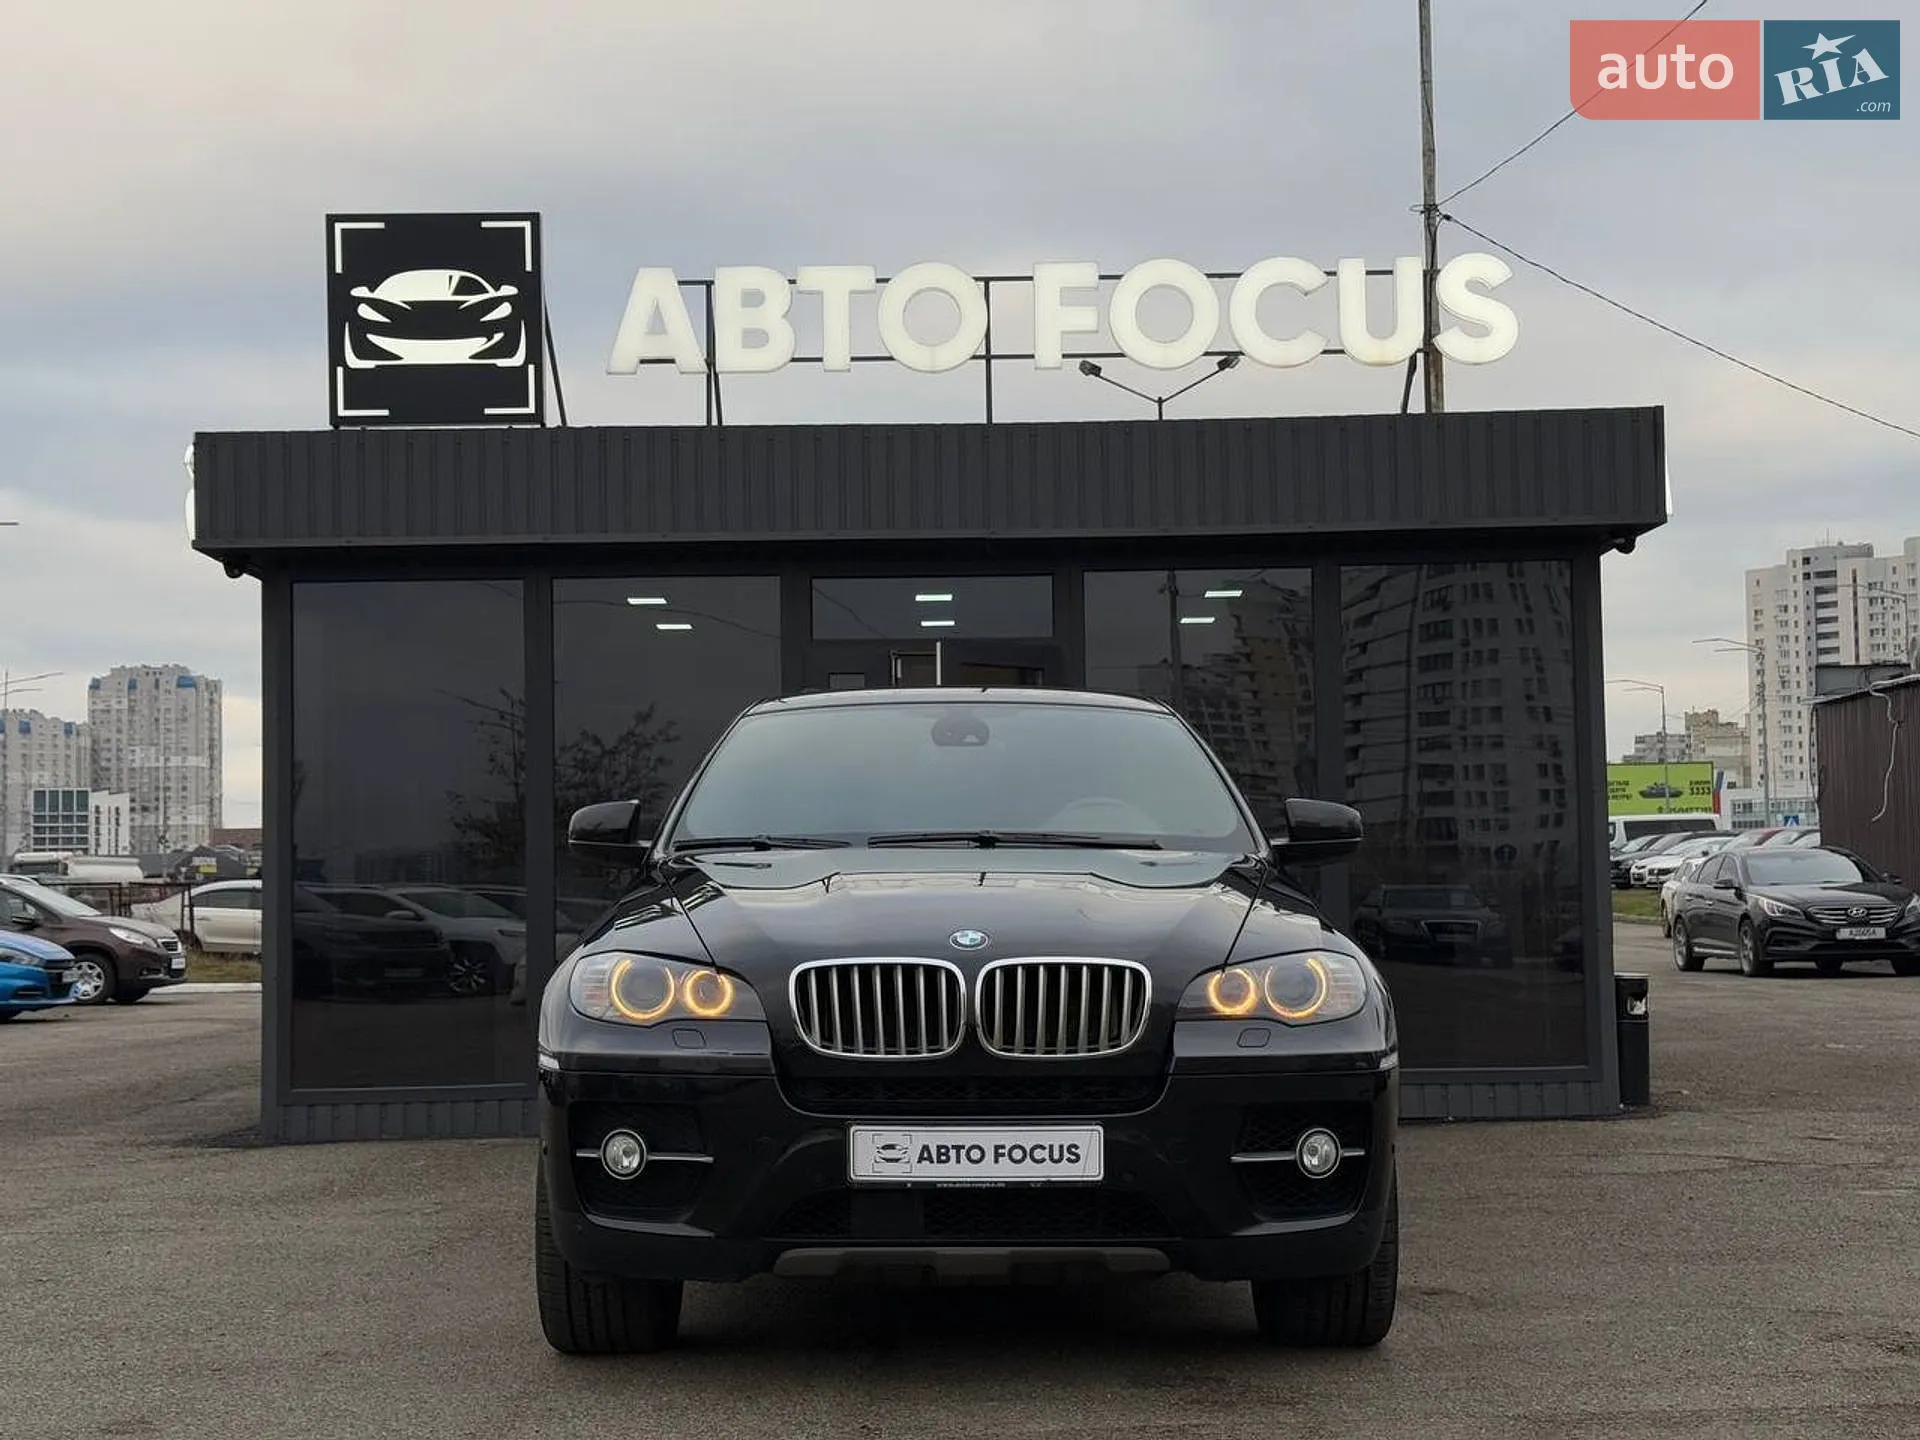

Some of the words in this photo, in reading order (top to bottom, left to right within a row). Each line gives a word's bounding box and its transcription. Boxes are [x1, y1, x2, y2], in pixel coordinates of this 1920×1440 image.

[606, 262, 990, 375] АВТО
[1033, 252, 1521, 370] FOCUS
[916, 1144, 986, 1165] АВТО
[993, 1143, 1082, 1165] FOCUS
